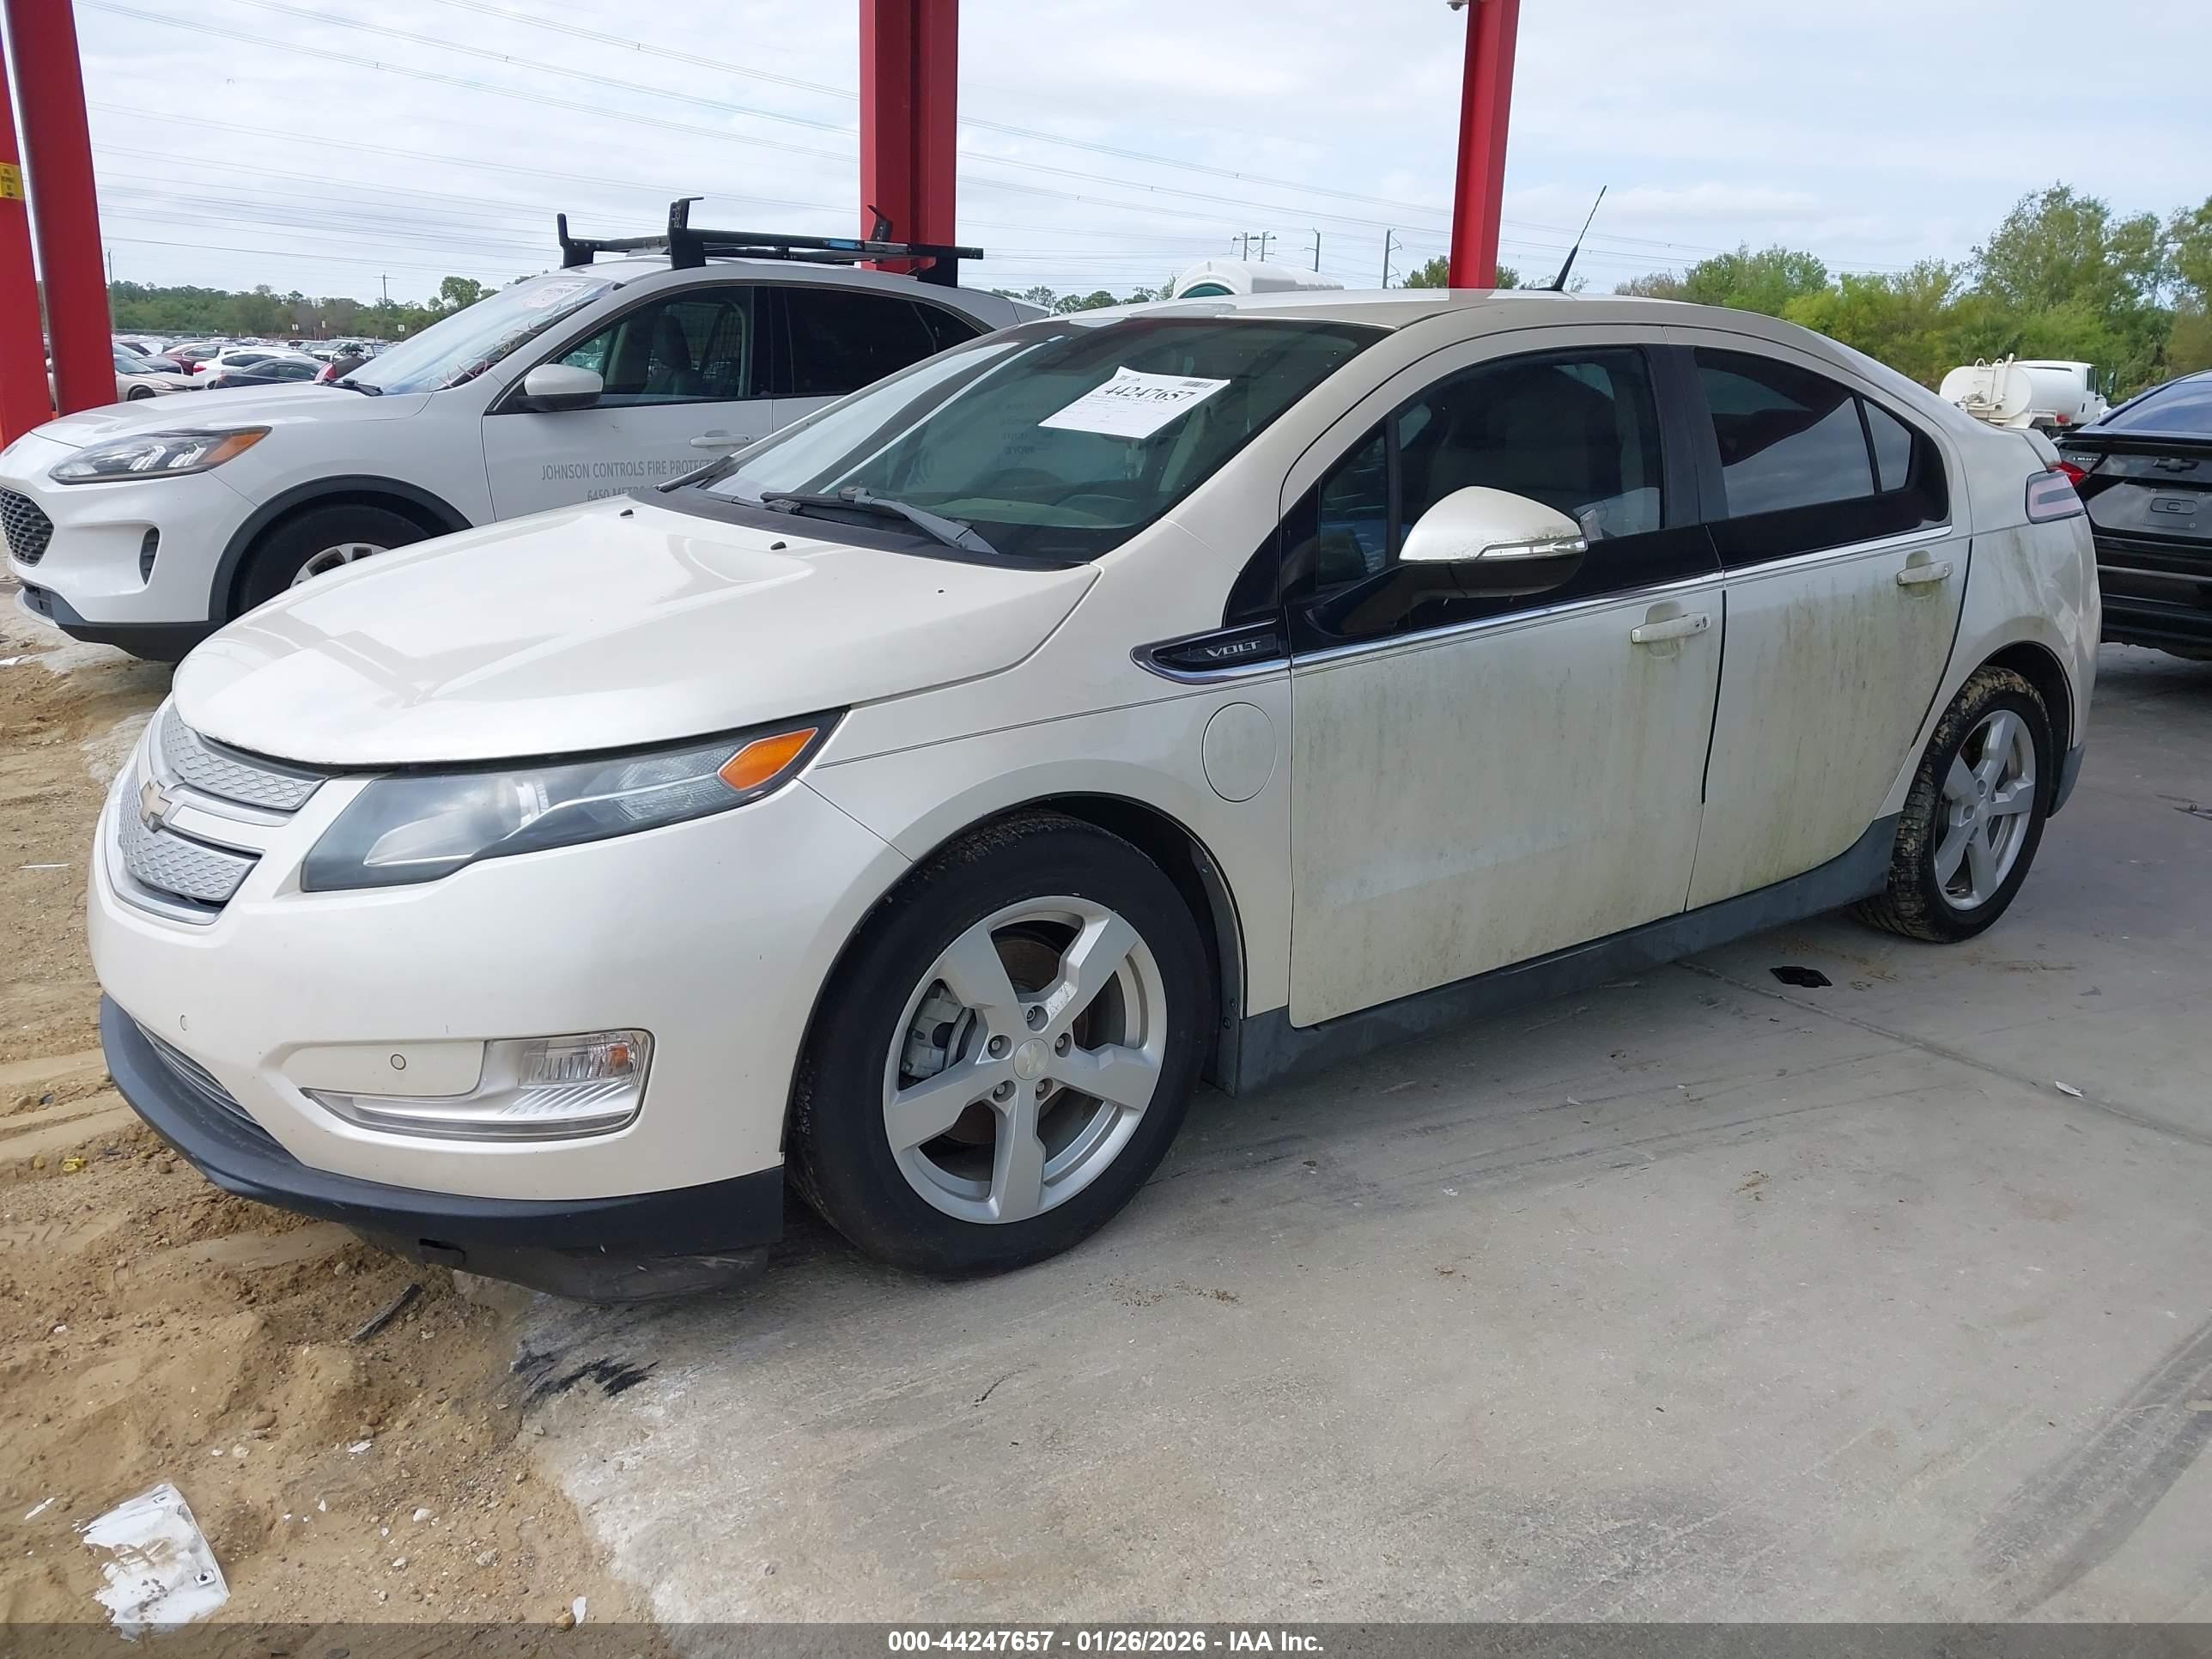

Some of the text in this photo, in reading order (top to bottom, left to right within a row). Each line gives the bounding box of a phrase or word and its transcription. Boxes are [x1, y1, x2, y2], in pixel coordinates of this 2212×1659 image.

[1104, 386, 1198, 403] 44247657
[542, 464, 590, 481] JOHNSON
[592, 461, 644, 478] CONTROLS
[647, 460, 667, 475] FIRE
[1206, 641, 1261, 657] VOLT
